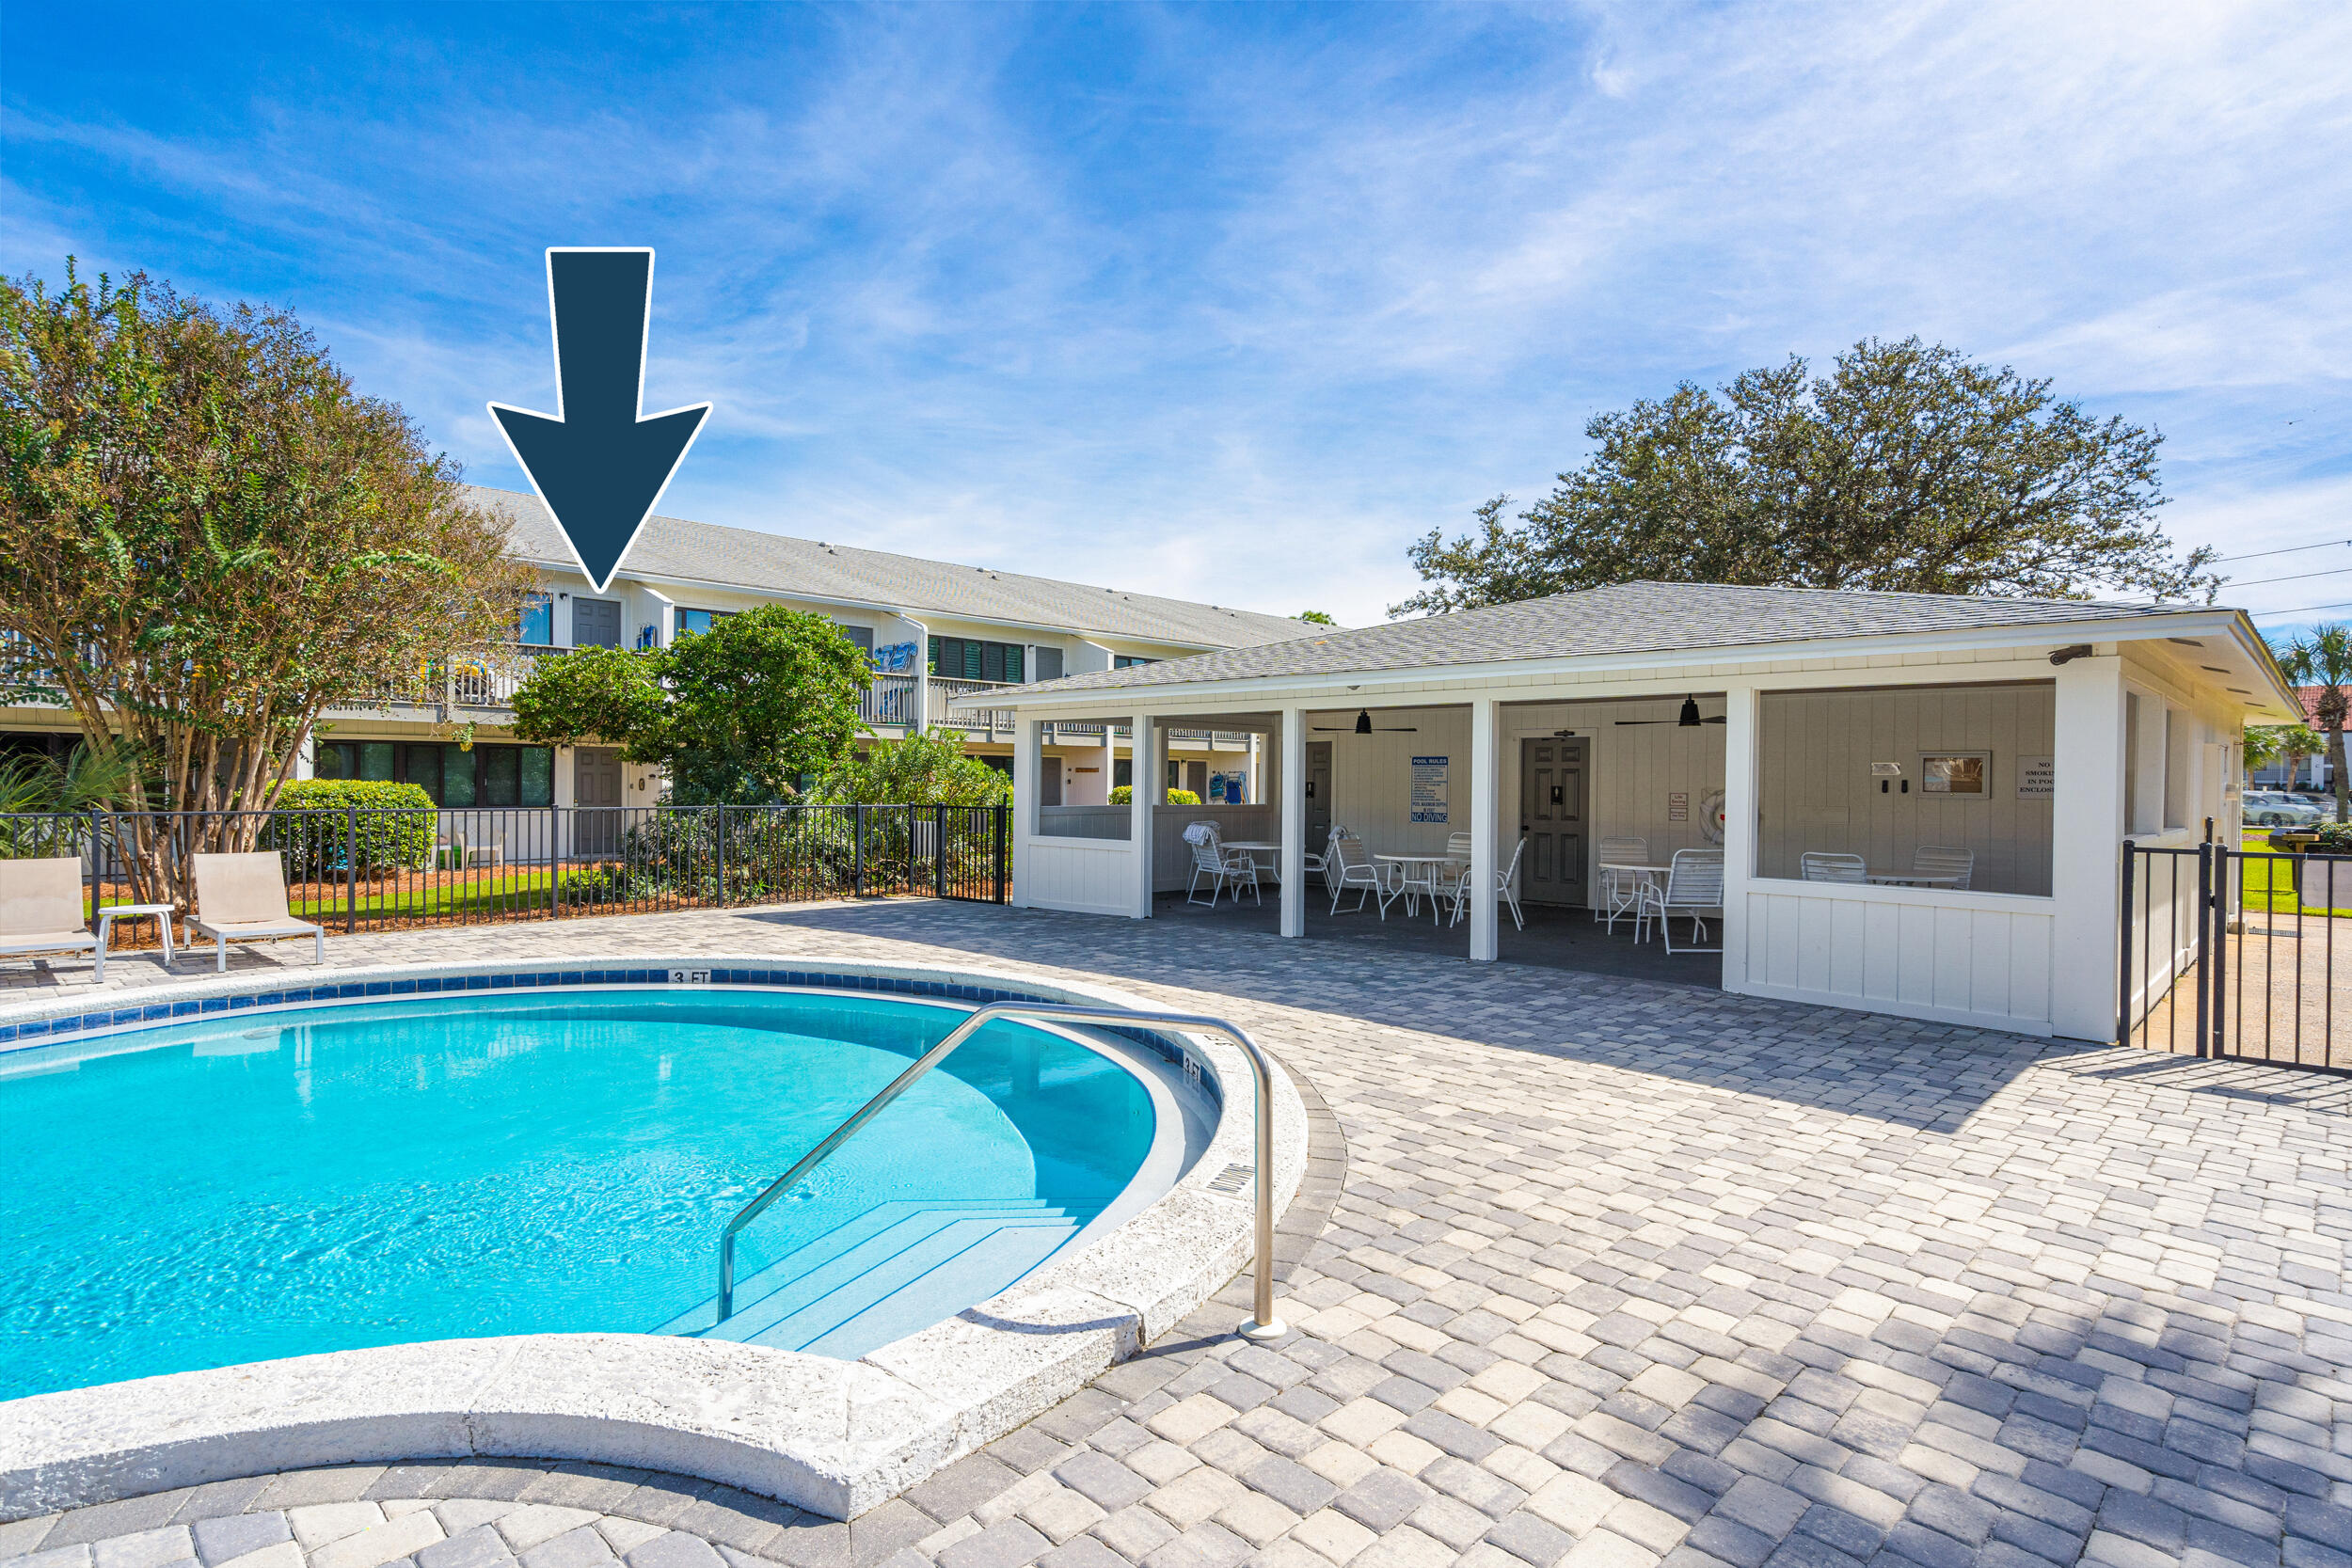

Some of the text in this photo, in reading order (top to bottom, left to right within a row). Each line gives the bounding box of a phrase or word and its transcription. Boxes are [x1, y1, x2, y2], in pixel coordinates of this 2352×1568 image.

[1412, 813, 1447, 821] NO DIVING
[674, 972, 708, 984] 3 FT
